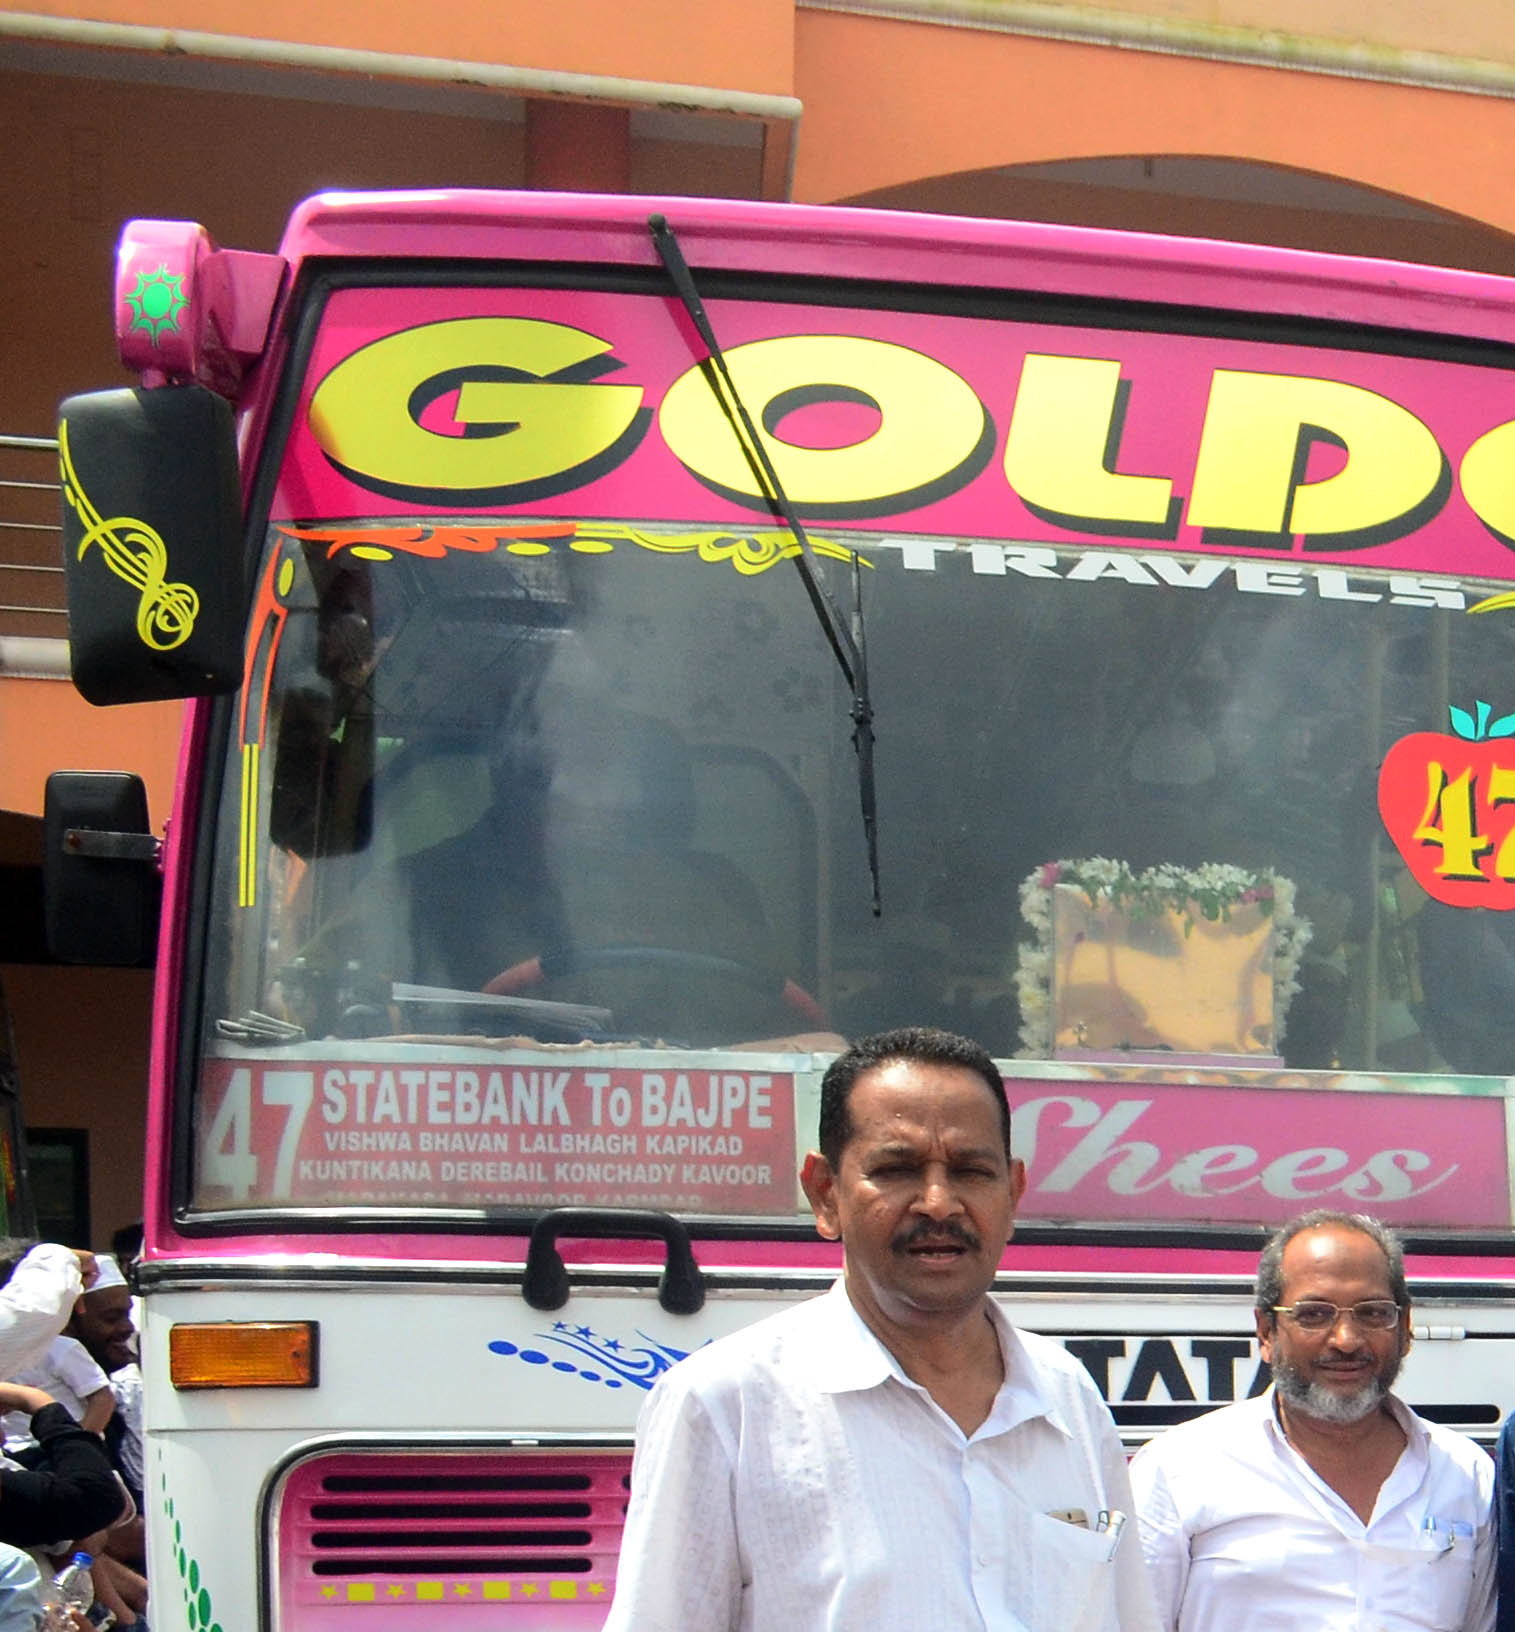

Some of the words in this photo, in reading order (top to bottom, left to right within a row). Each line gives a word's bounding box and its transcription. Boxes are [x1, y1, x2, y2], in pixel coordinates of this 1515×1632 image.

[879, 538, 1467, 610] TRAVELS
[321, 1068, 572, 1127] STATEBANK
[584, 1072, 632, 1128] To
[640, 1073, 773, 1129] BAJPE
[202, 1068, 313, 1201] 47
[324, 1131, 412, 1152] VISHWA
[419, 1132, 509, 1154] BHAVAN
[519, 1133, 638, 1156] LALBHAGH
[645, 1135, 744, 1157] KAPIKAD
[300, 1159, 432, 1182] KUNTIKANA
[440, 1160, 549, 1184] DEREBAIL
[555, 1162, 678, 1185] KONCHADY
[681, 1164, 772, 1186] KAVOOR
[1065, 1340, 1271, 1401] TAT
